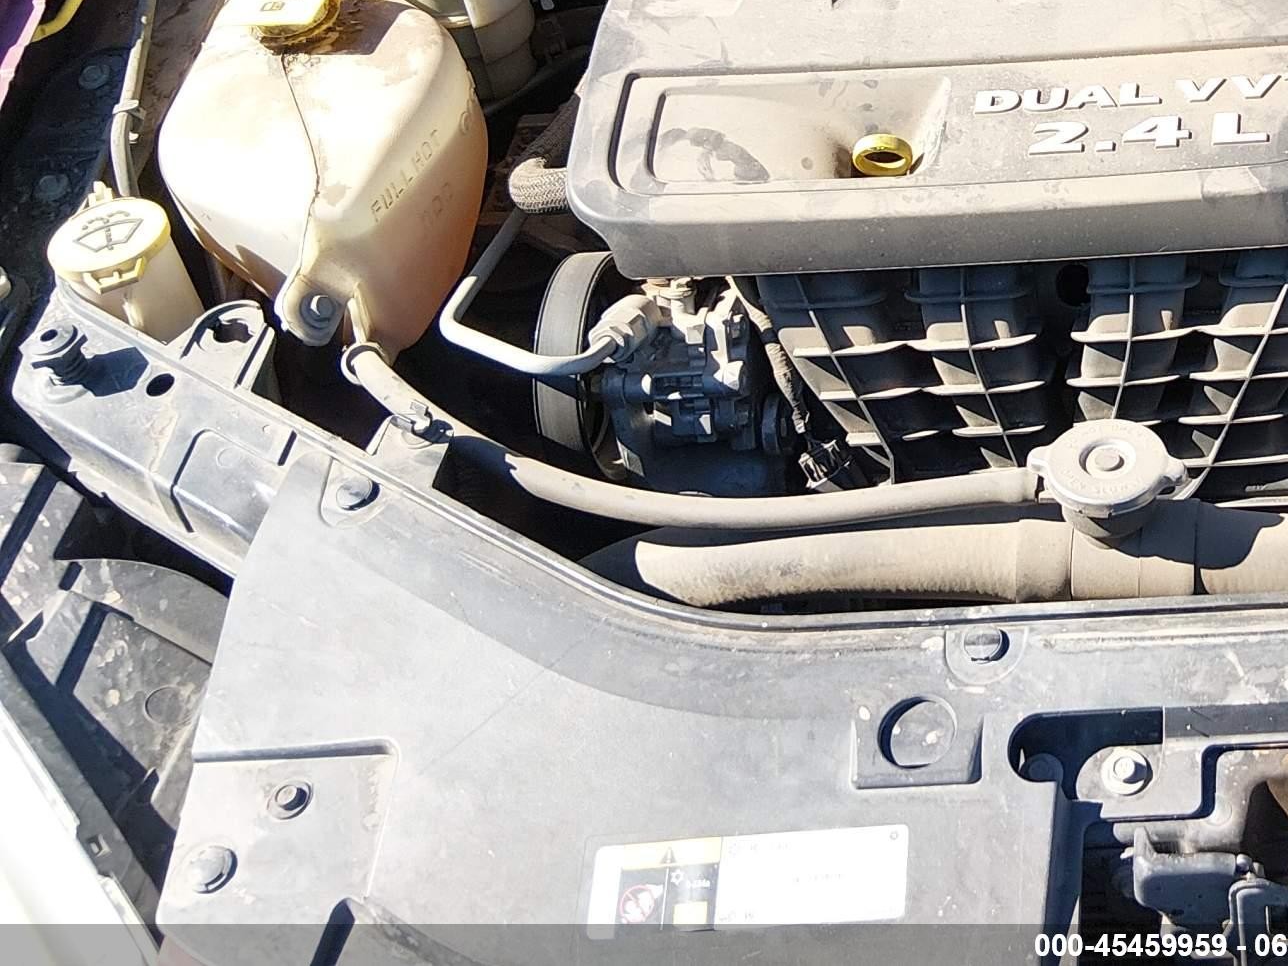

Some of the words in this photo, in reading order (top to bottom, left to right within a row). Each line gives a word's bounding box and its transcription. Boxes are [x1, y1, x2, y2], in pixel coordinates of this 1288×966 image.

[975, 83, 1161, 114] DUAL
[1029, 115, 1192, 155] 2.4
[1212, 113, 1270, 145] L
[369, 169, 414, 223] FULL
